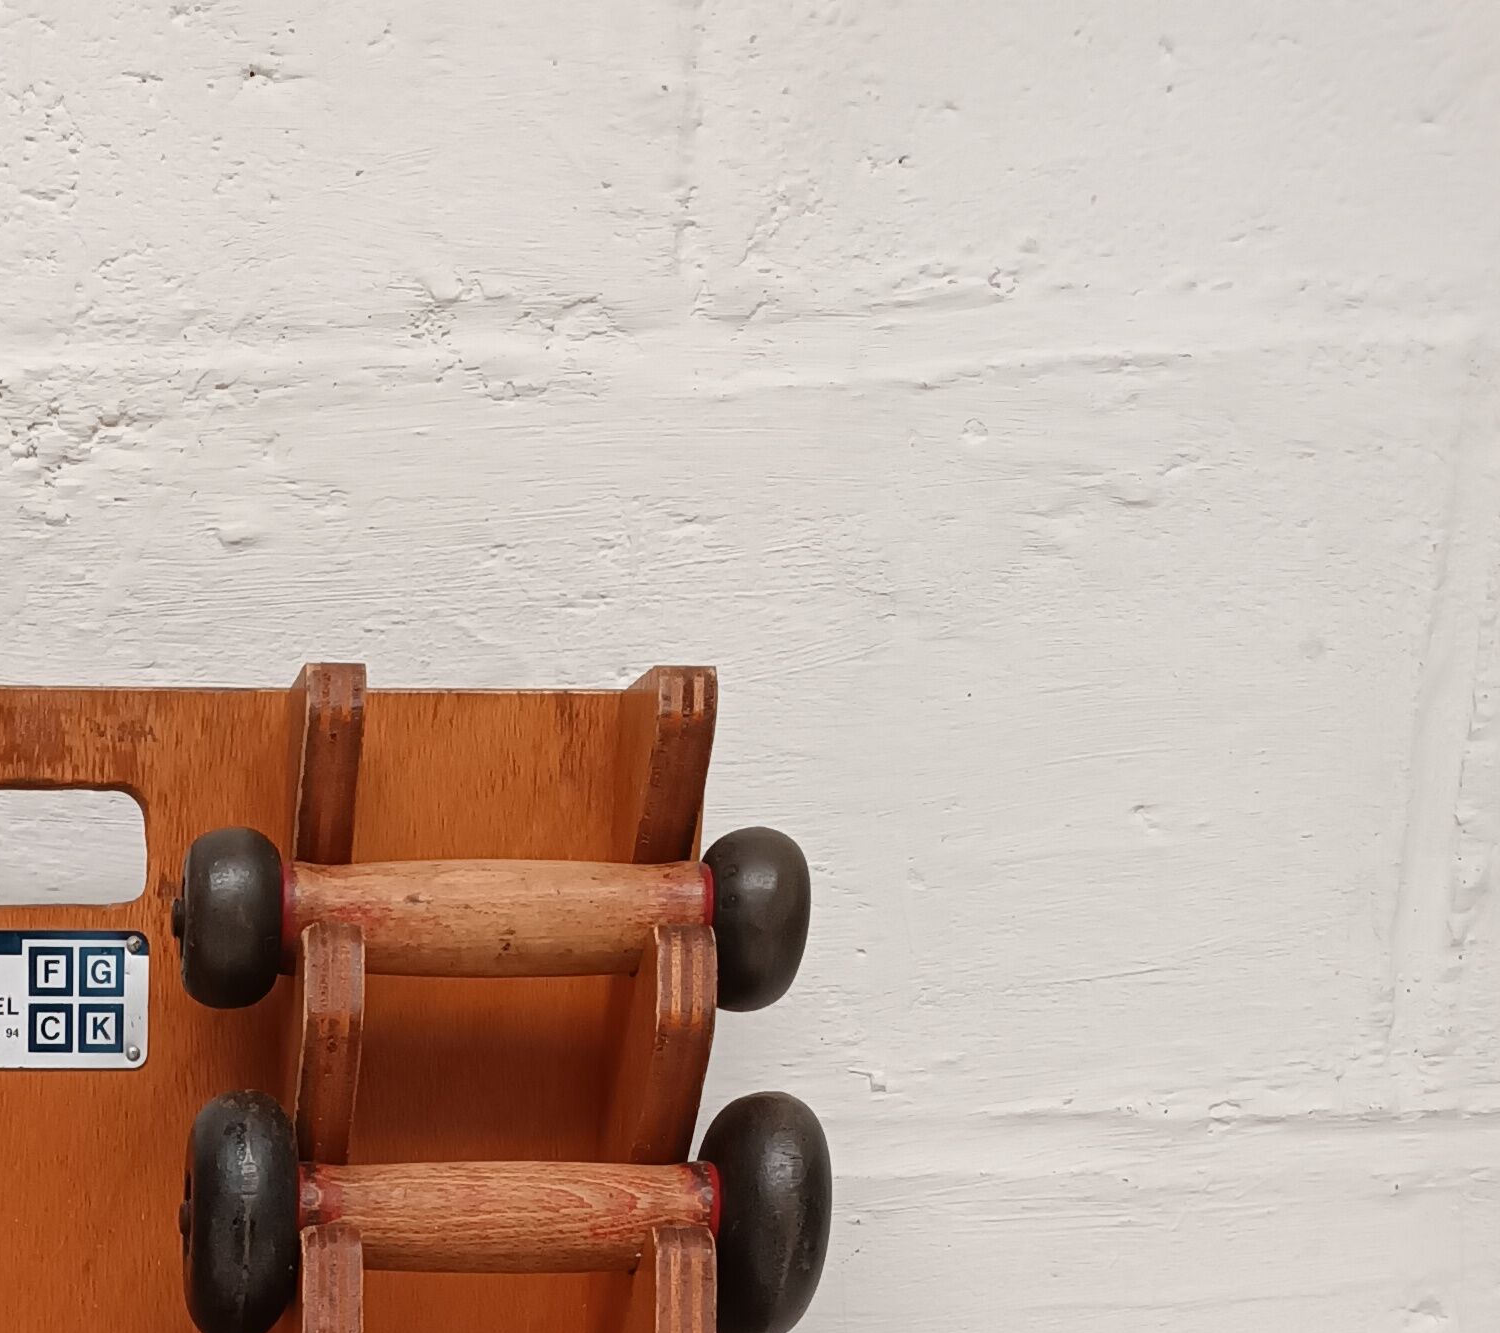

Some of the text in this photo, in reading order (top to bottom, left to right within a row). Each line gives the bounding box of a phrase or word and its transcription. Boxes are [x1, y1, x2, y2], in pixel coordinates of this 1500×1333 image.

[43, 959, 112, 985] F G
[5, 1027, 19, 1039] 94
[40, 1015, 112, 1041] C K
